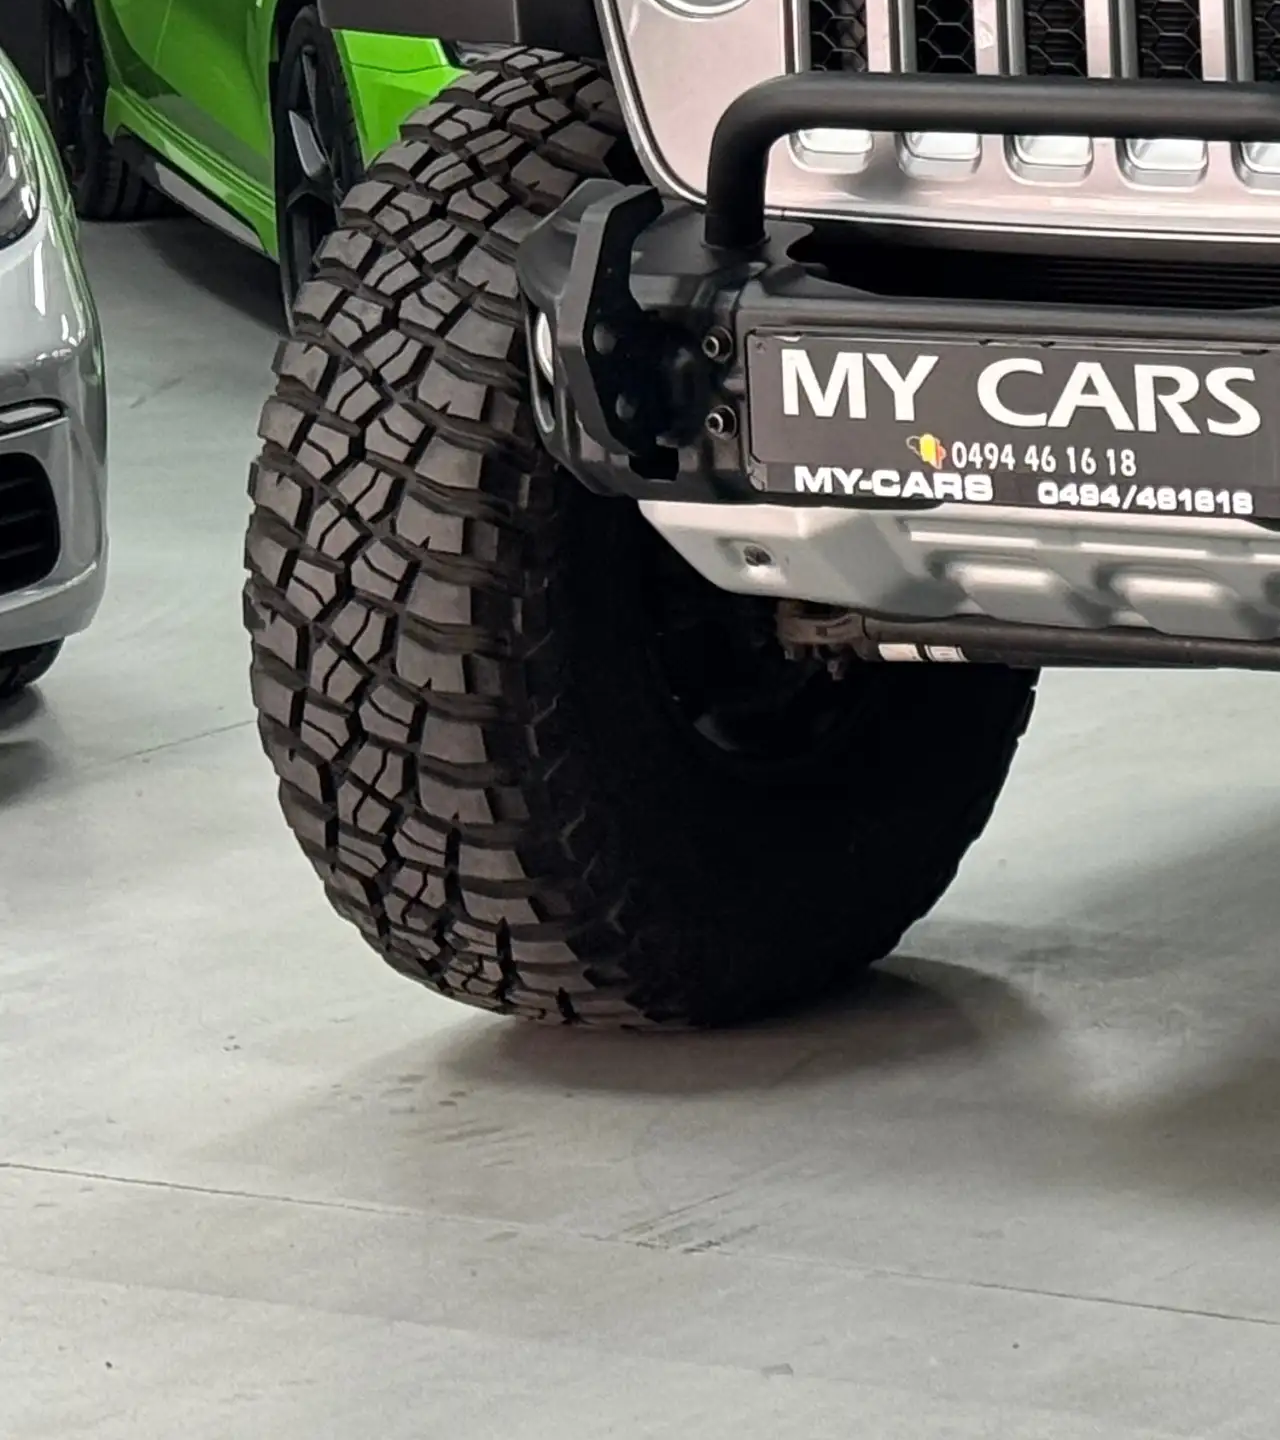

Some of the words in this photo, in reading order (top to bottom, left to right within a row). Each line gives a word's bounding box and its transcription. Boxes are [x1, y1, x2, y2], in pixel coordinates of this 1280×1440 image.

[779, 348, 939, 422] MY
[976, 358, 1263, 438] CARS
[951, 441, 1016, 472] 0494
[1023, 444, 1057, 474] 46
[1066, 446, 1098, 476] 16
[1105, 447, 1137, 478] 18
[793, 464, 994, 503] MY-CARS
